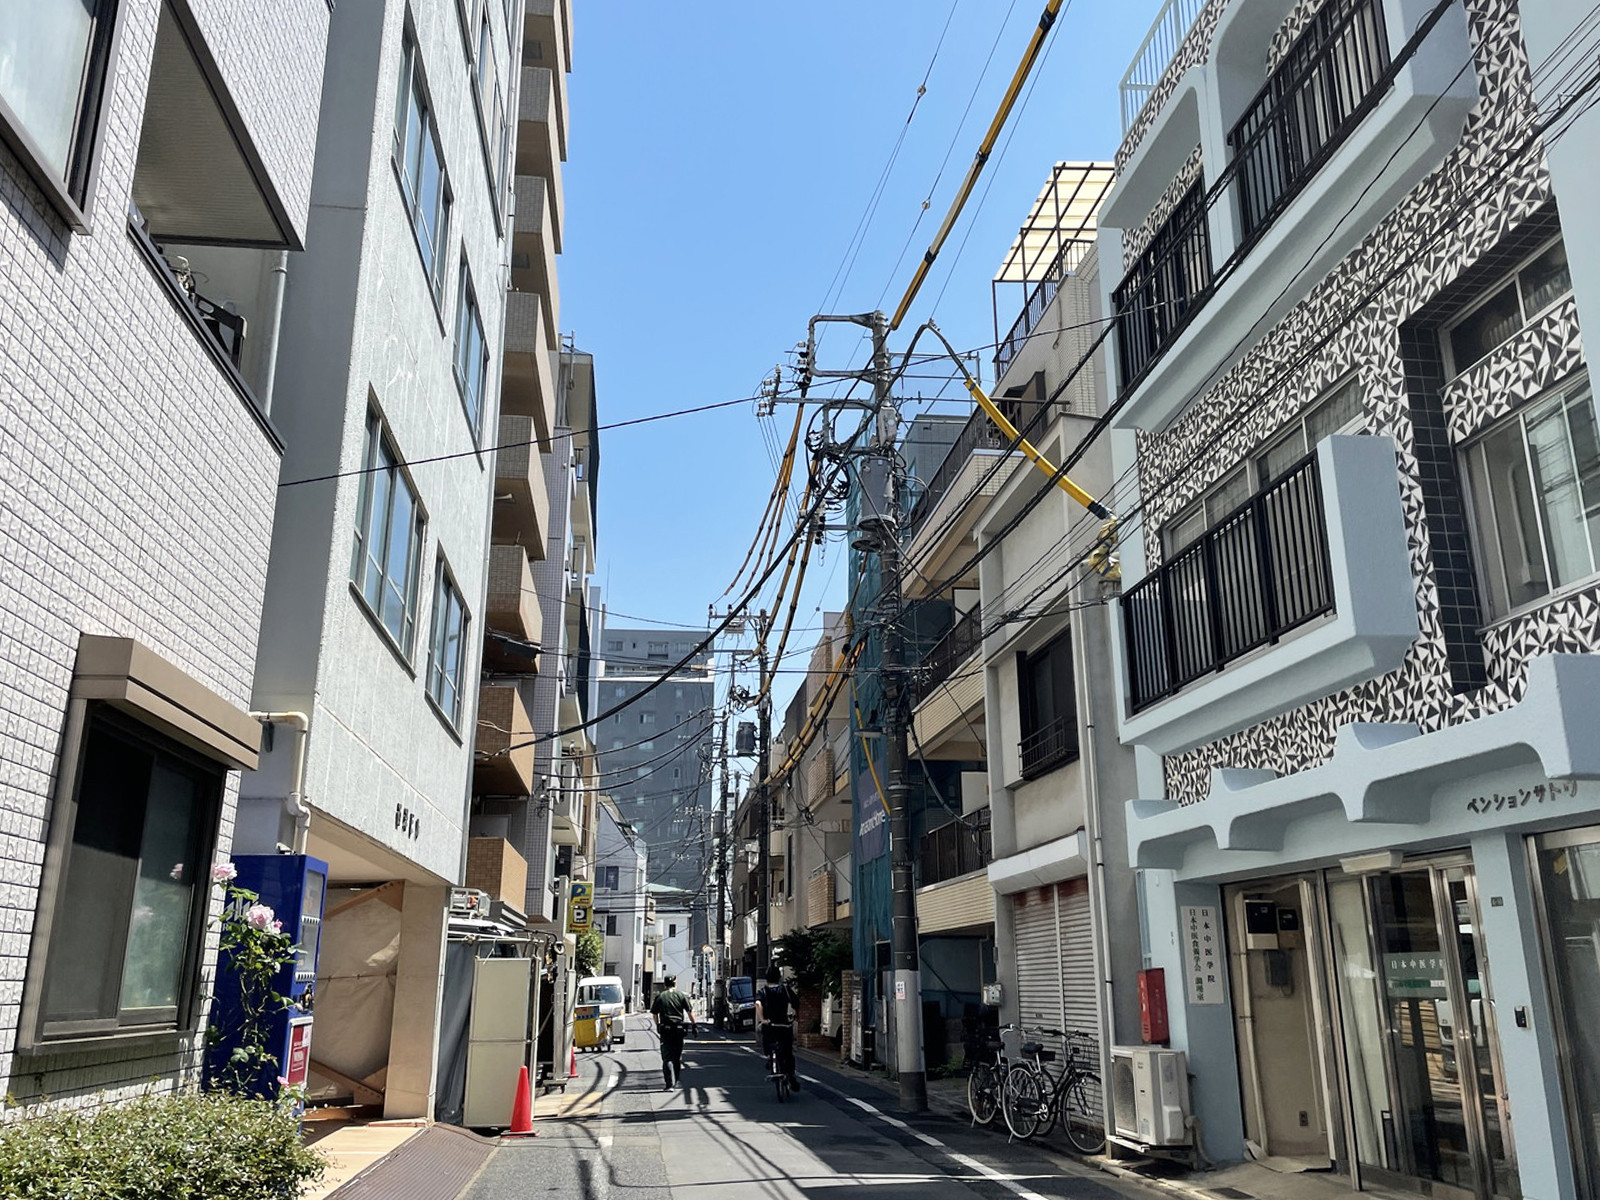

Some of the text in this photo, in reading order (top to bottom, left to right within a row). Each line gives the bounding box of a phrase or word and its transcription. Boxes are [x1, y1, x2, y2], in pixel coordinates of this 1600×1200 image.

[573, 909, 585, 922] P
[1201, 908, 1216, 983] 日本中医学院
